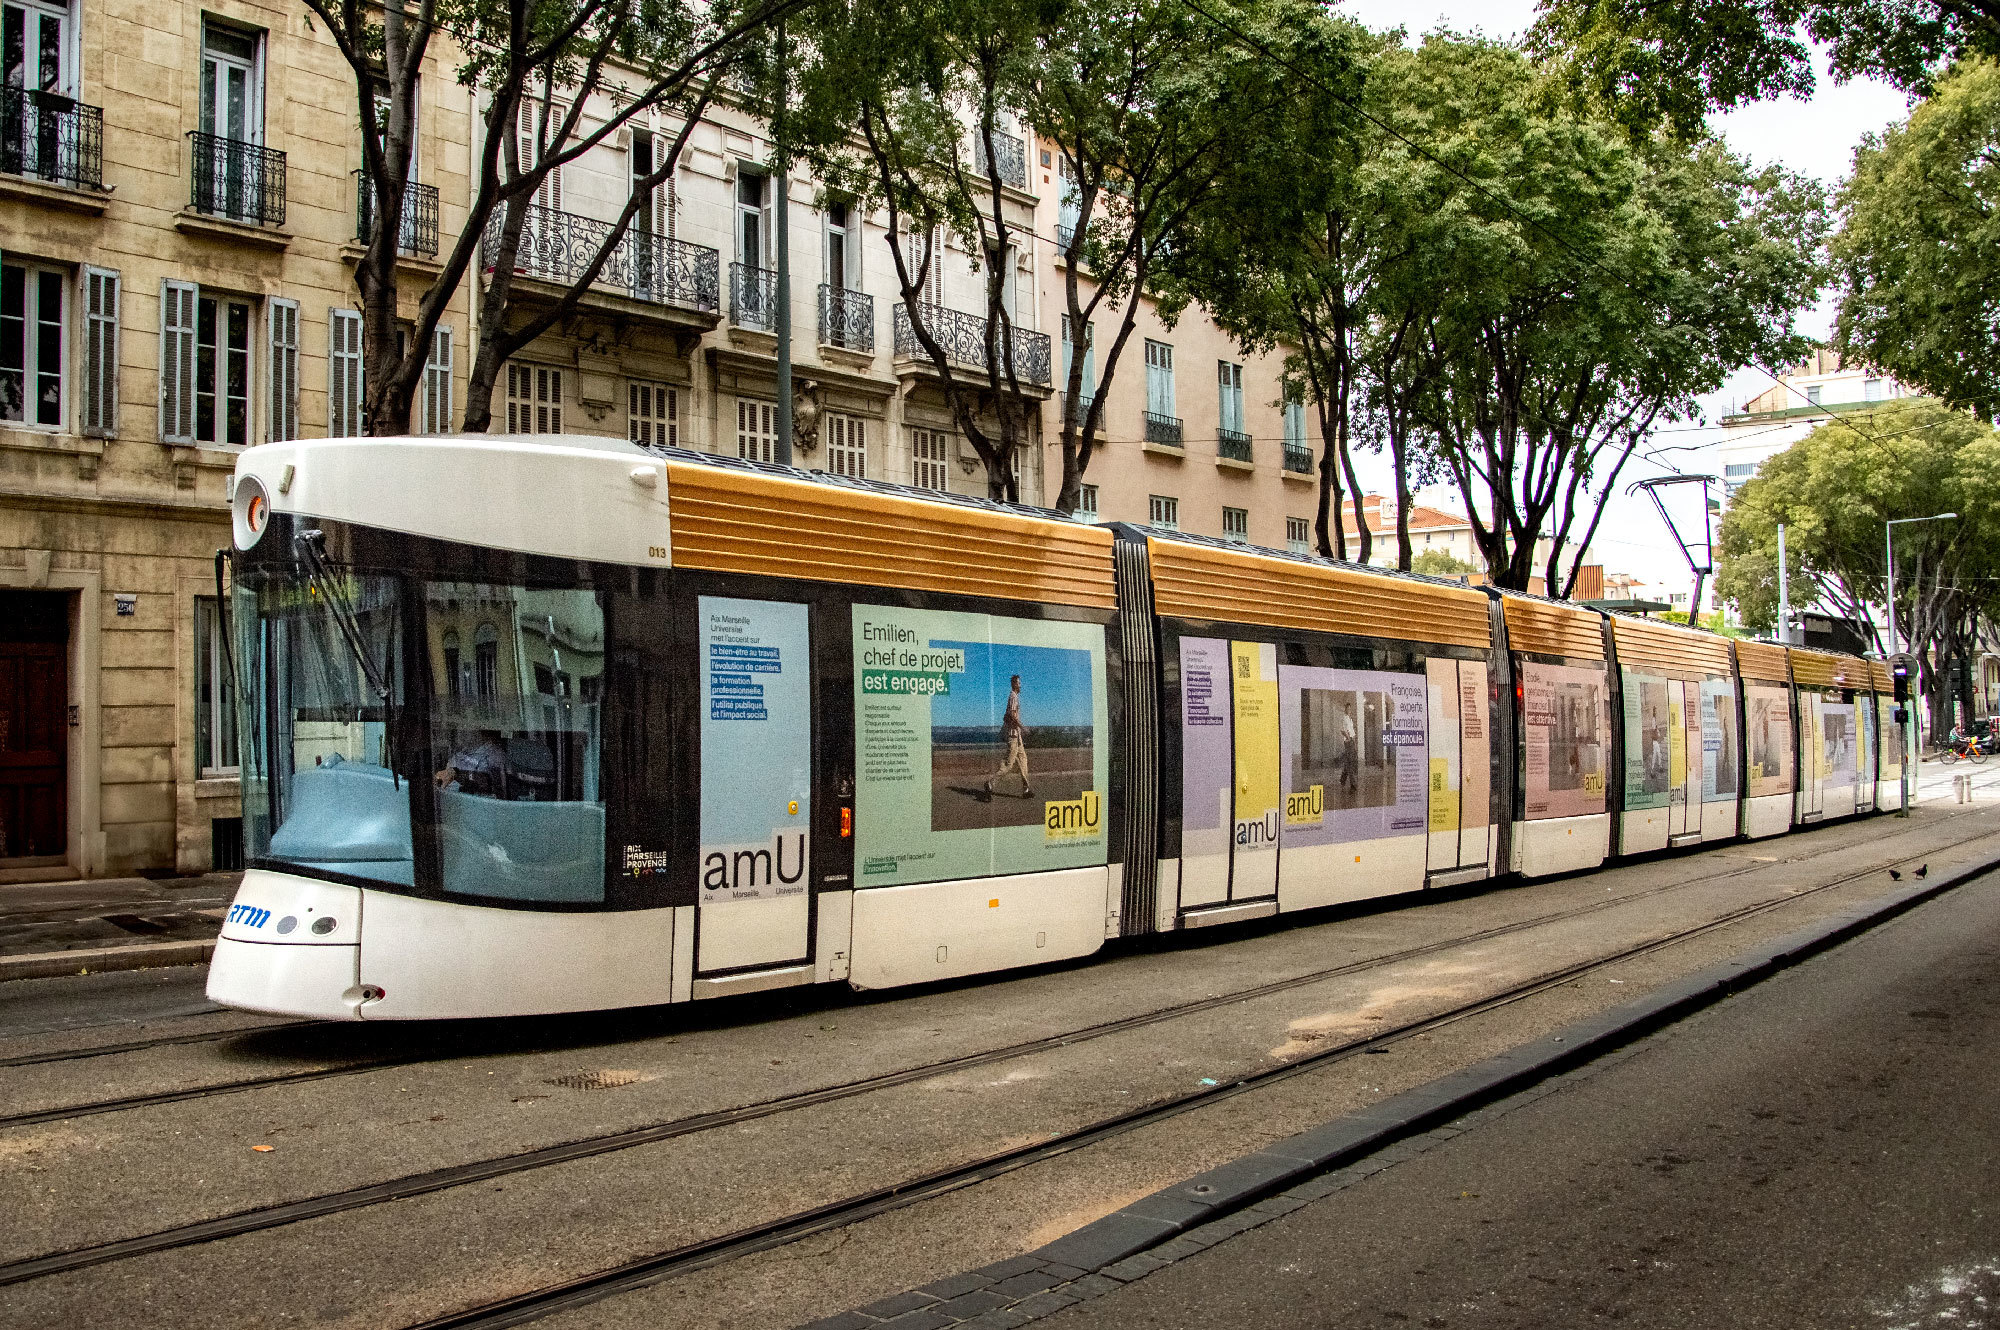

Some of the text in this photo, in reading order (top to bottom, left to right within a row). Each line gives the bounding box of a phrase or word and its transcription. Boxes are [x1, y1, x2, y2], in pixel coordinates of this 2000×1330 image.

[649, 546, 666, 559] 013
[118, 602, 134, 613] 250
[711, 614, 750, 625] Aix Marseille
[711, 625, 743, 634] Université
[863, 621, 919, 646] Emilien,
[711, 634, 724, 642] met
[725, 634, 749, 644] l'accent
[711, 647, 718, 655] le
[719, 647, 749, 656] bien-être
[864, 646, 964, 672] chef de projet,
[712, 660, 744, 670] l'évolution
[745, 662, 753, 671] de
[712, 675, 750, 685] la formation
[864, 672, 949, 695] est engagé.
[735, 700, 762, 710] publique
[712, 710, 719, 718] et
[1382, 731, 1393, 745] est
[1288, 789, 1322, 817] amU
[1048, 795, 1099, 829] amU
[1236, 812, 1277, 845] amU
[627, 844, 641, 853] AIX
[627, 851, 667, 861] MARSEILLE
[703, 833, 805, 890] amU
[627, 859, 667, 869] PROVENCE
[733, 890, 760, 899] Marseille
[775, 886, 804, 895] Université
